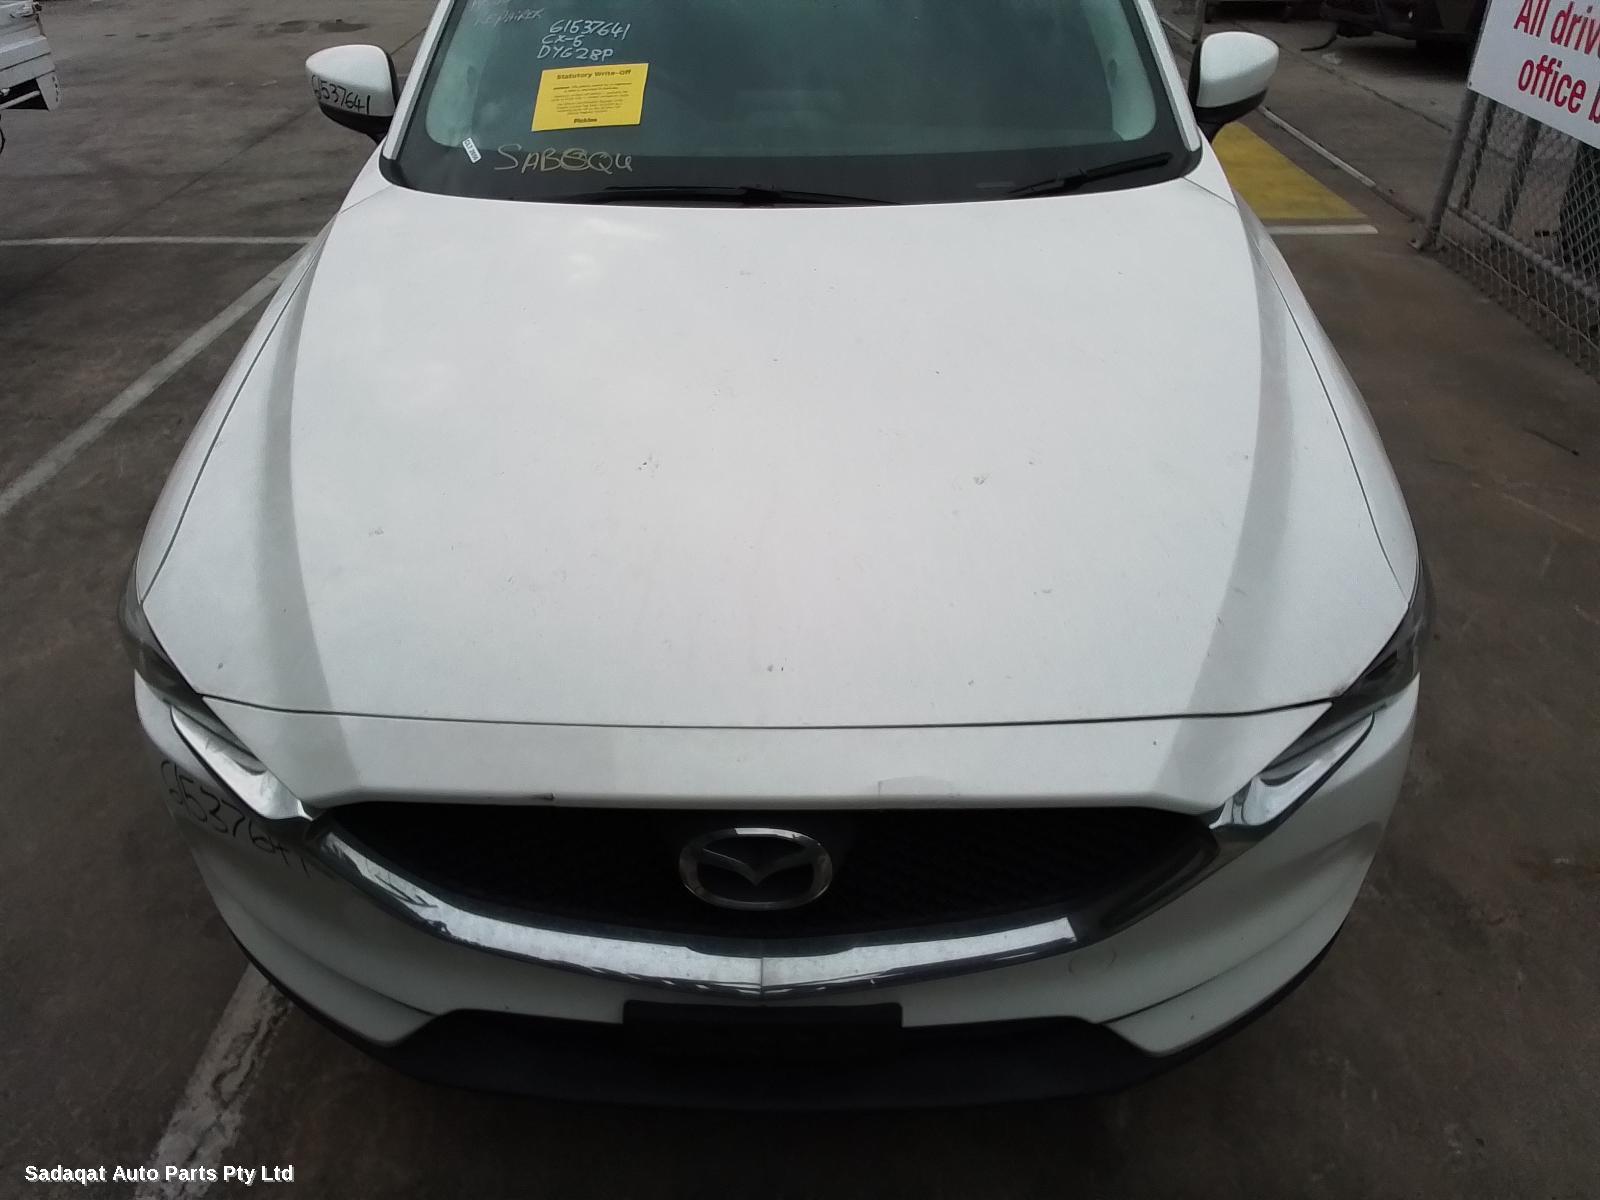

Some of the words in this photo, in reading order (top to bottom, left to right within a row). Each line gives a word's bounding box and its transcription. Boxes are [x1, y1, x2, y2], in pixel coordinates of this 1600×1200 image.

[549, 19, 631, 40] 61537641
[1513, 0, 1551, 38] All
[1550, 1, 1600, 59] driv
[556, 71, 593, 80] Statutory
[594, 69, 632, 78] Write-Off
[1518, 54, 1587, 113] office
